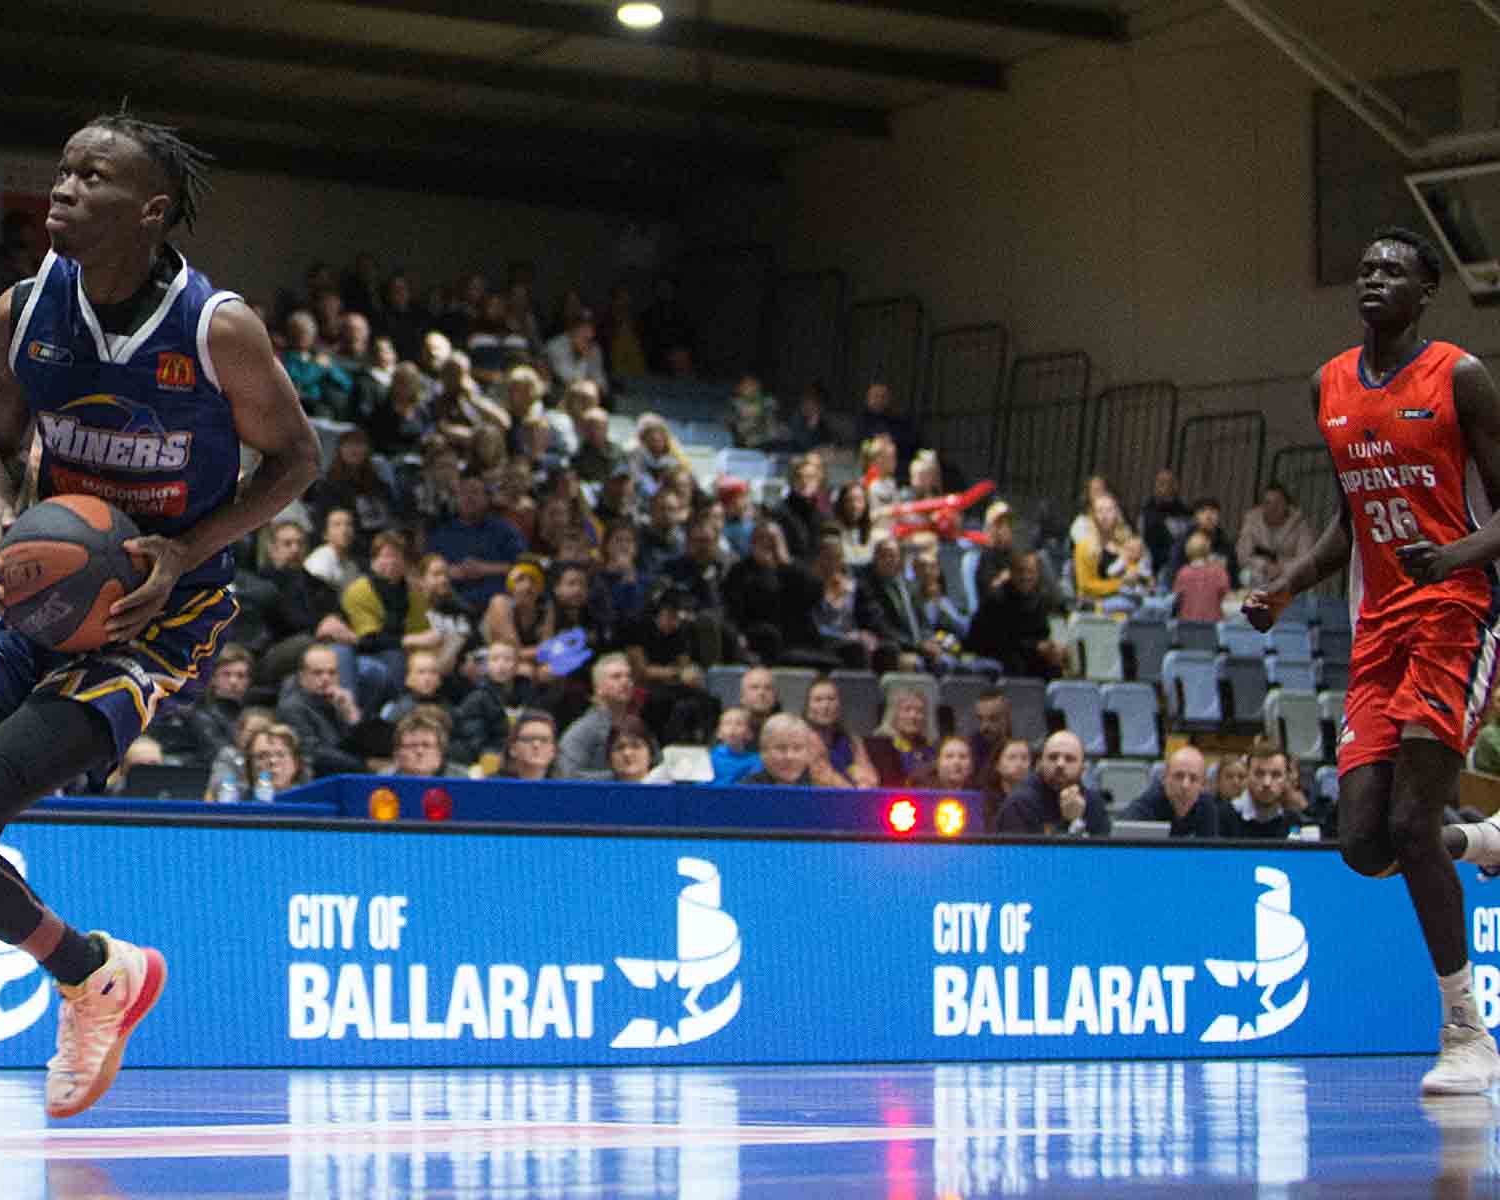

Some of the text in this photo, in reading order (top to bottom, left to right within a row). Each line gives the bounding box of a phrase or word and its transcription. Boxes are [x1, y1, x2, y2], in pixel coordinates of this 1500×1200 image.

[38, 412, 192, 471] MINERS
[1348, 440, 1395, 459] LUINA
[1364, 497, 1418, 544] 36
[288, 894, 408, 950] CITY OF
[933, 903, 1032, 954] CITY OF
[288, 963, 604, 1040] BALLARAT
[934, 965, 1195, 1036] BALLARAT
